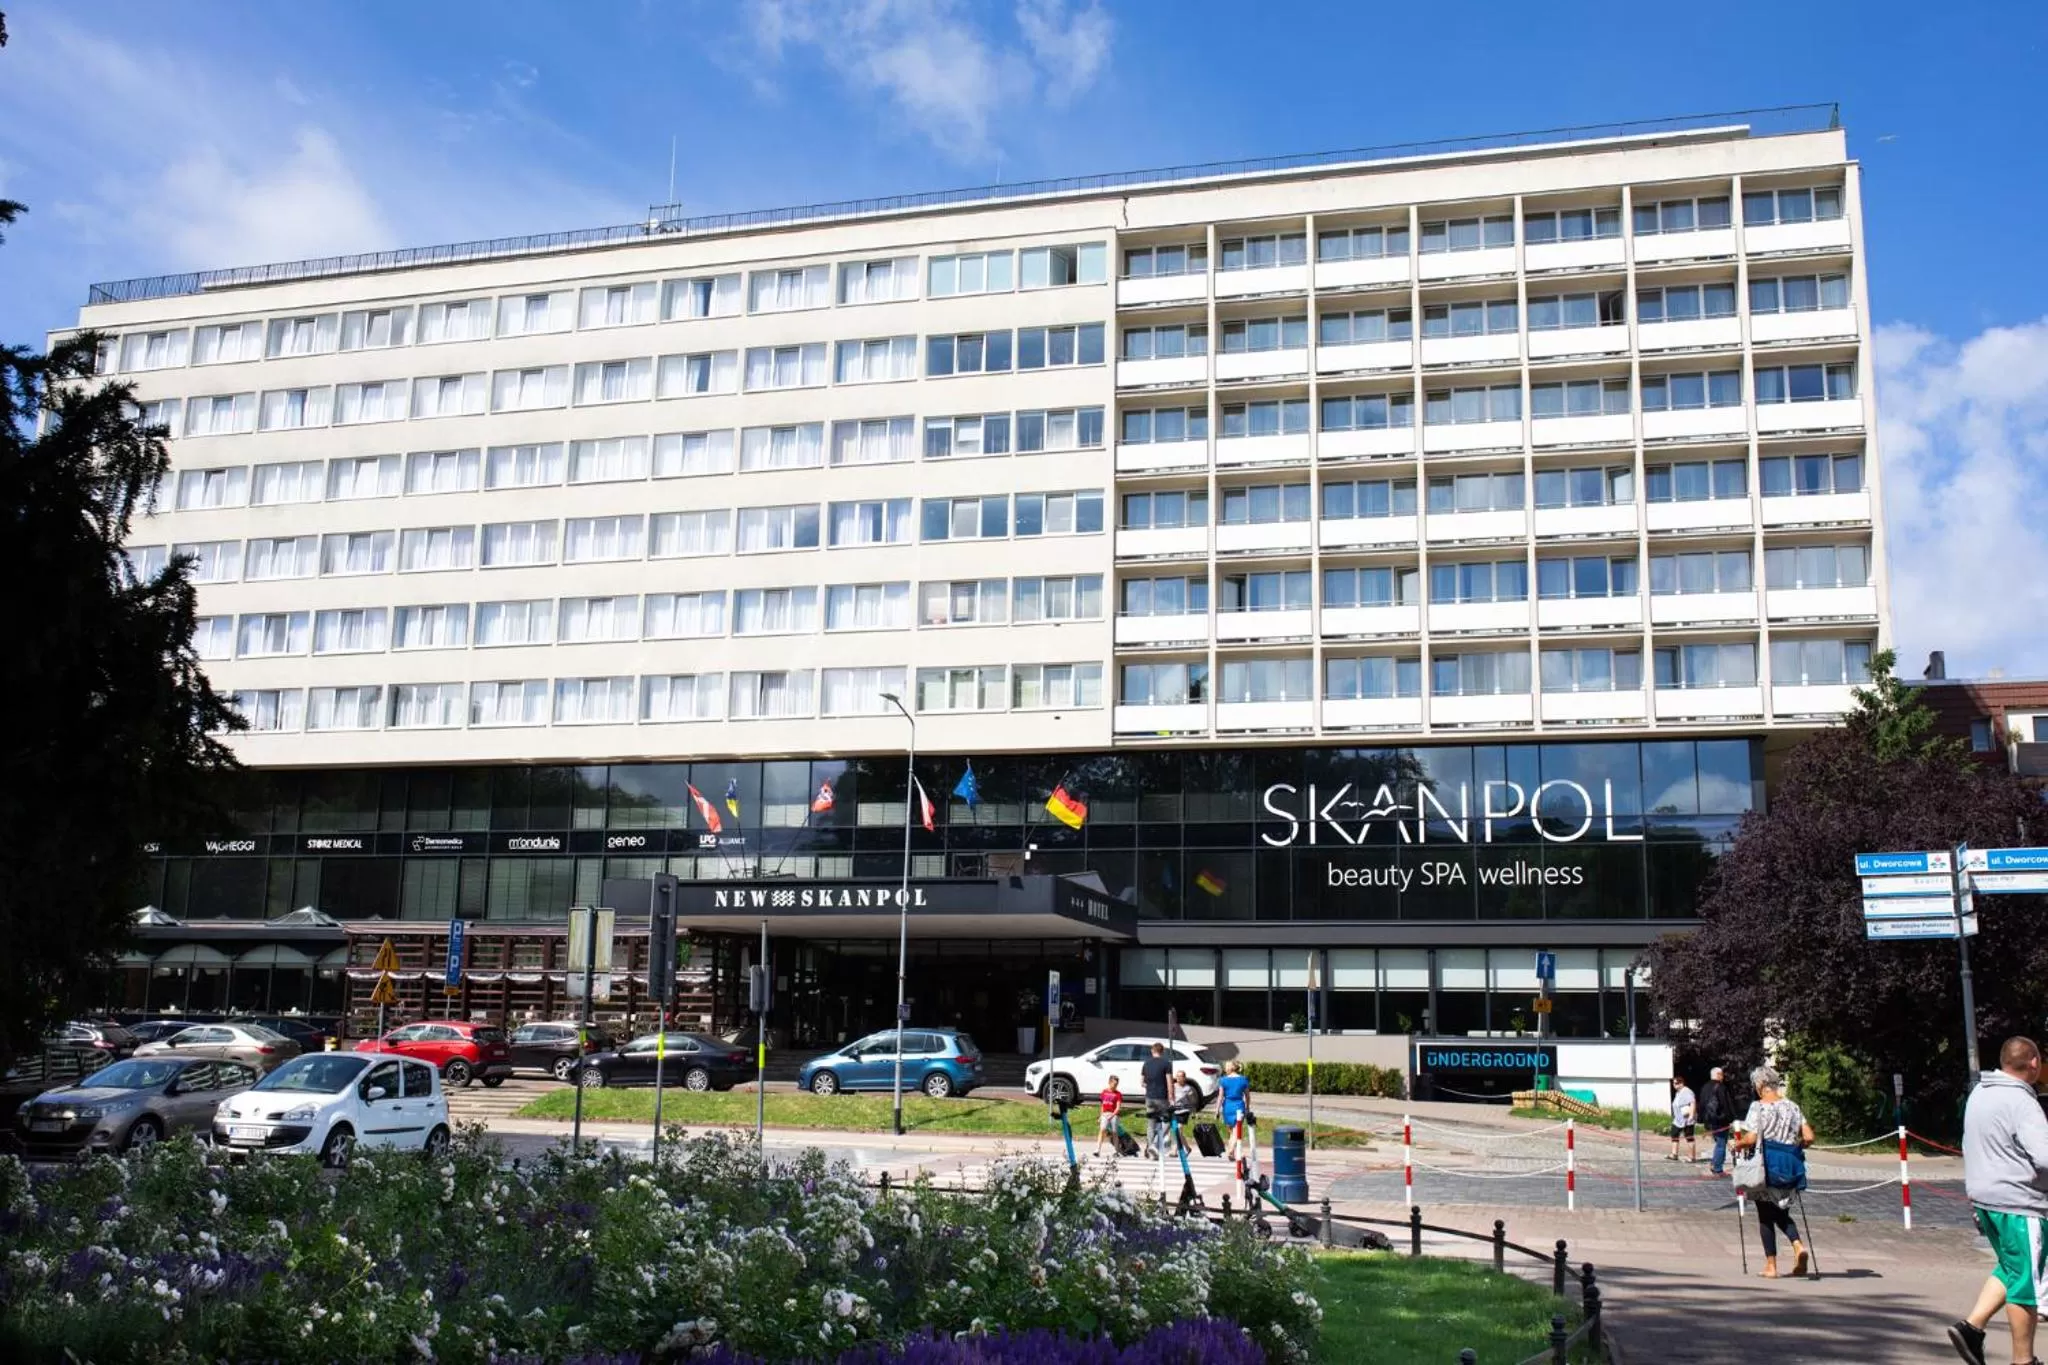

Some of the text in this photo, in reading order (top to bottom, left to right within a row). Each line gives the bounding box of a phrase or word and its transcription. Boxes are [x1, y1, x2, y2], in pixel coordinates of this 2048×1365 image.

[1261, 778, 1645, 847] SKANPOL
[332, 837, 363, 848] MEDICAL
[607, 835, 646, 848] geneo
[1859, 859, 1922, 869] ul. Dworcowa
[1327, 861, 1584, 892] beauty SPA wellness
[714, 888, 926, 907] NEW SKANPOL
[1427, 1051, 1549, 1067] UNDERGROUND
